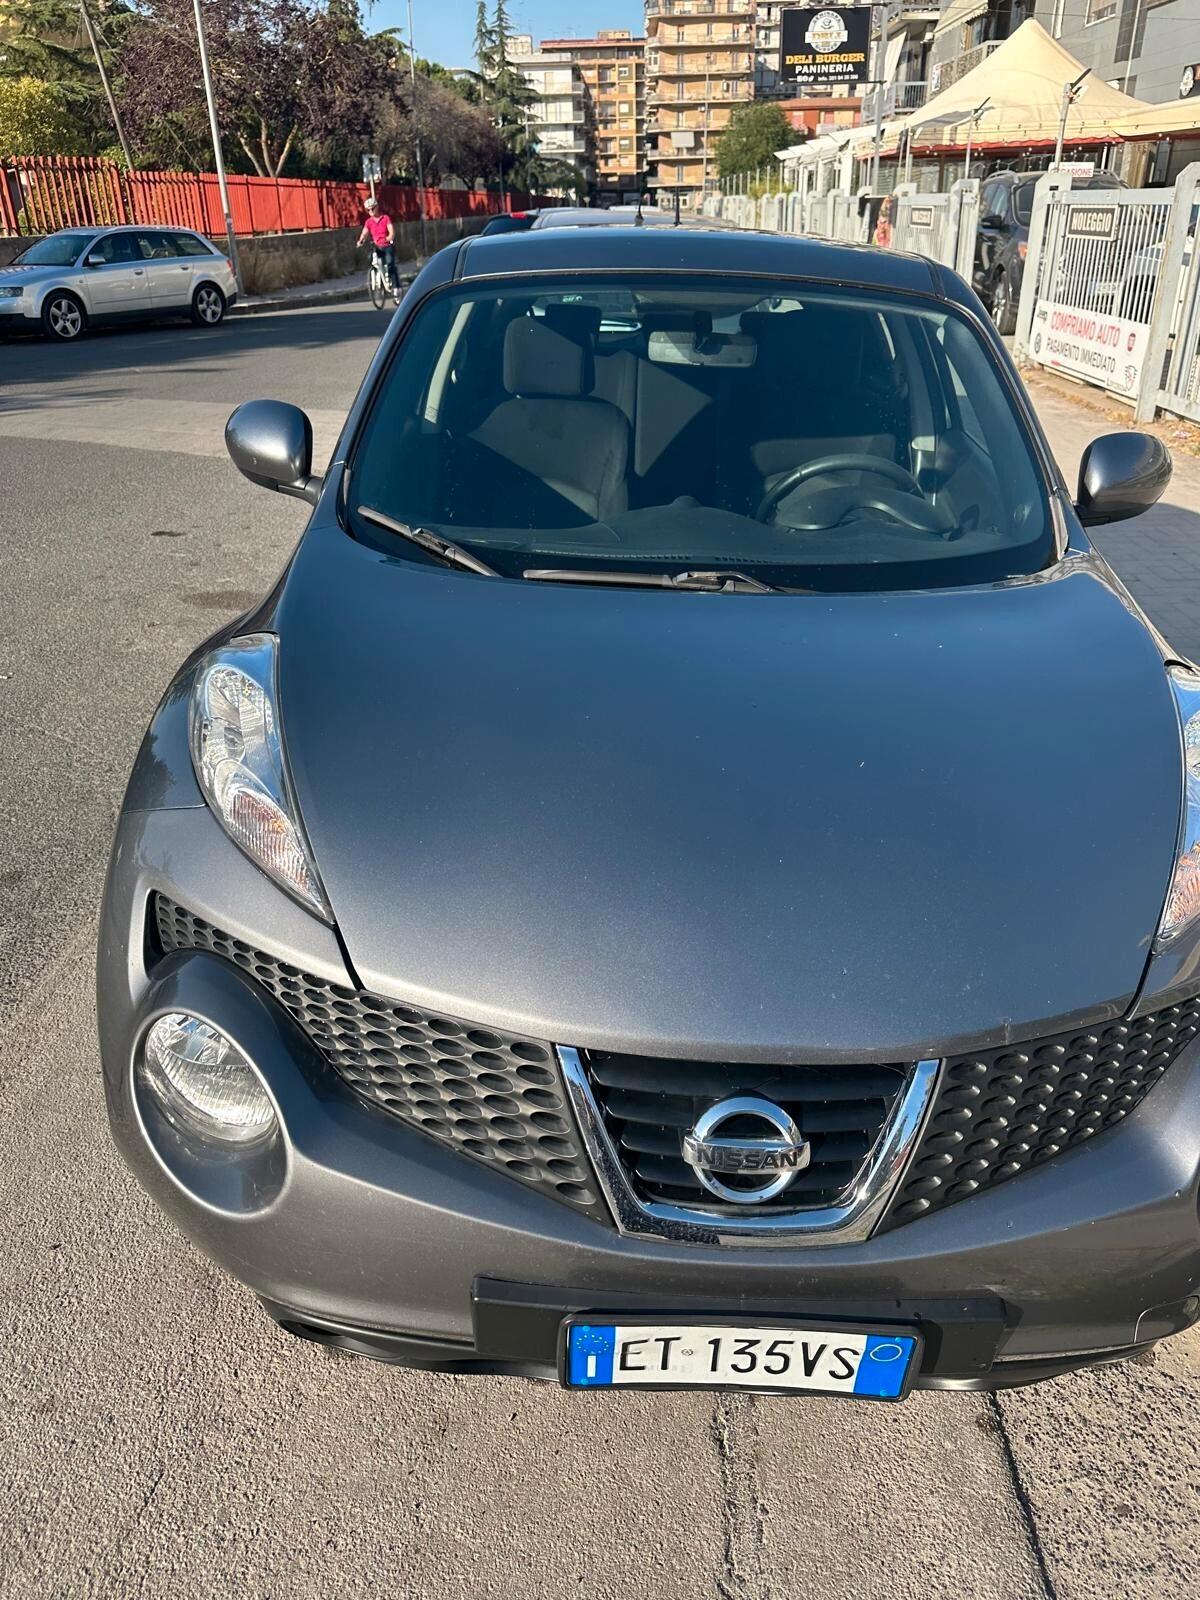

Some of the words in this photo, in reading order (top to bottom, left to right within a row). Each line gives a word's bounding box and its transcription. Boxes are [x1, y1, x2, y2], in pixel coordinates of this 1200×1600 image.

[785, 55, 813, 64] DELI
[815, 53, 865, 63] BURGER
[795, 64, 854, 74] PANINERIA
[1071, 211, 1113, 233] NOLEGGIO
[1050, 311, 1096, 341] COMPRIAMO
[1097, 323, 1121, 348] AUTO
[1080, 348, 1116, 374] IMMEDIATO
[697, 1148, 798, 1168] NISSAN
[618, 1336, 682, 1372] ET
[707, 1337, 862, 1381] 135VS
